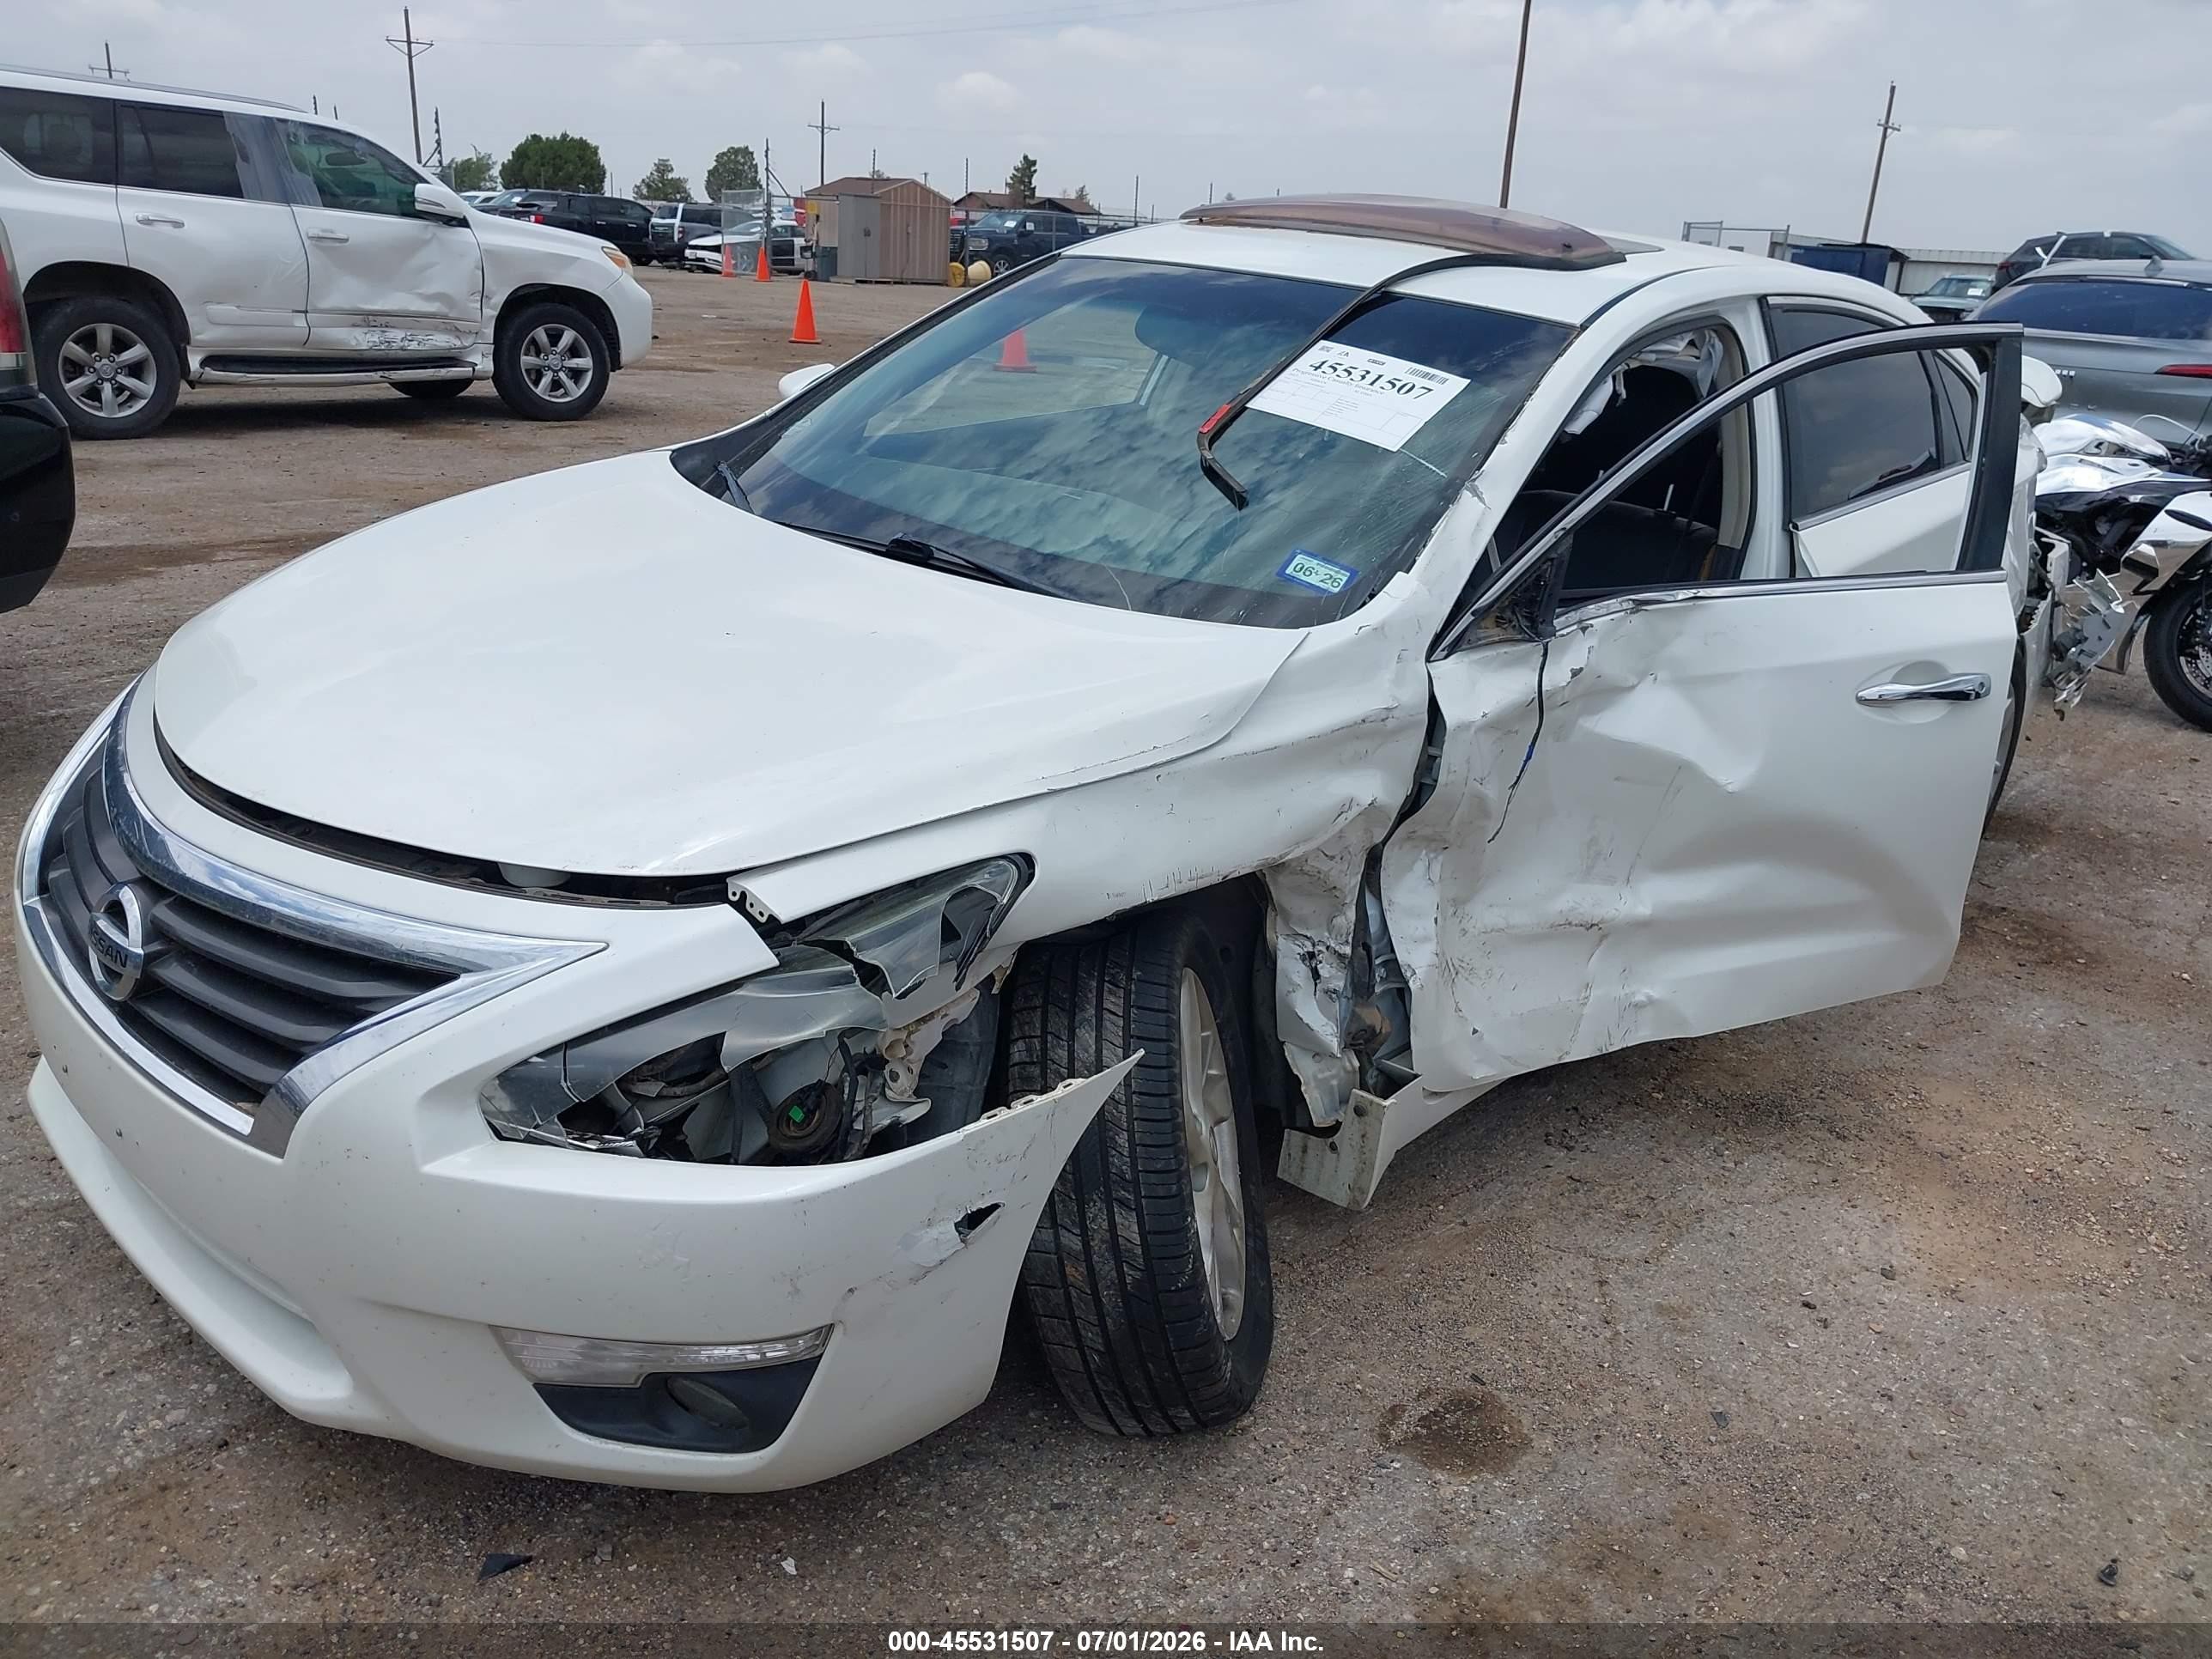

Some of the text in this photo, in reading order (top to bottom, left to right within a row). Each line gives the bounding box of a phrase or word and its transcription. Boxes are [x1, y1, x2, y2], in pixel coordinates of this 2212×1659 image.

[1309, 359, 1434, 400] 45531507
[1292, 562, 1316, 578] 06
[1318, 573, 1344, 589] 26
